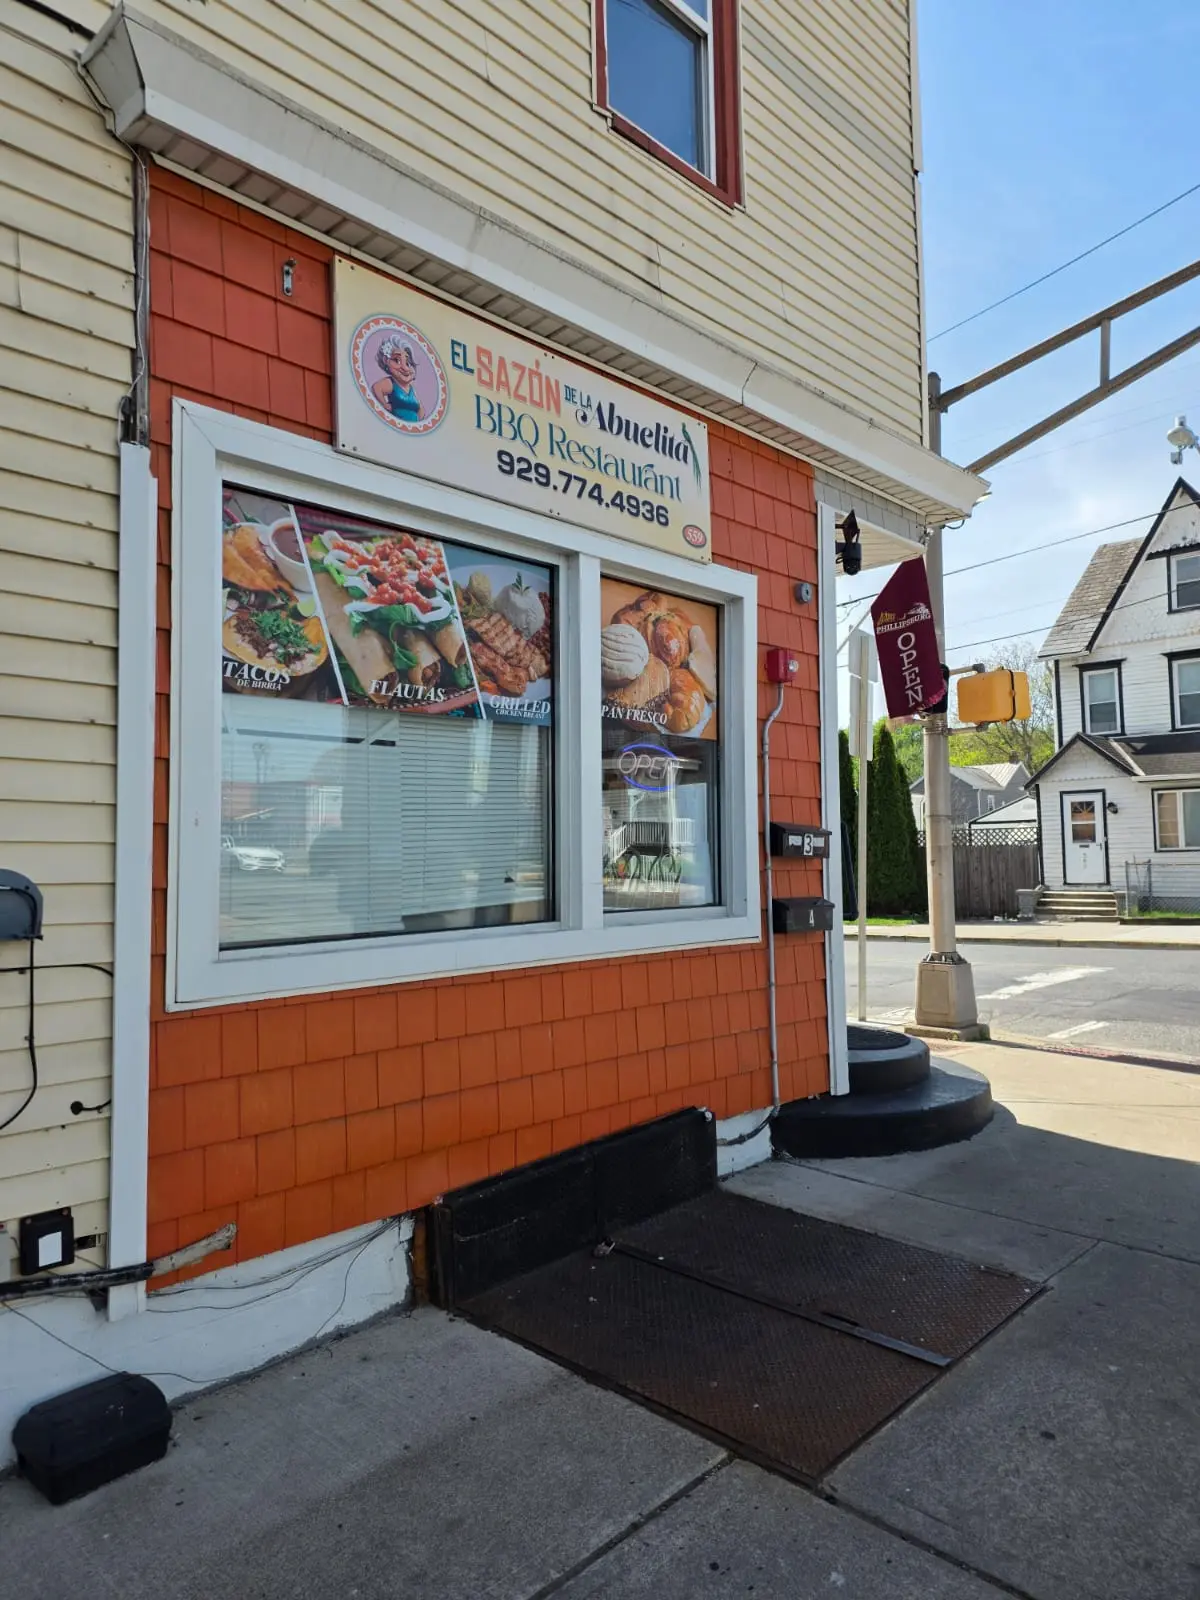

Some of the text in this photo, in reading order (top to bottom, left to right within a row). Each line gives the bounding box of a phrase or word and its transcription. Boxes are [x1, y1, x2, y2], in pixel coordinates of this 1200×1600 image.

[450, 338, 689, 464] EL SAZÓN DE LA Abuelita
[474, 393, 682, 502] BBQ Restaurant
[497, 449, 670, 527] 929.774.4936
[876, 613, 931, 635] PHILLIPSBURG
[223, 661, 291, 685] TACOS
[897, 632, 924, 707] OPEN
[237, 679, 282, 691] DE BIRRIA
[368, 679, 445, 702] FLAUTAS
[490, 694, 551, 714] GRILLED
[626, 708, 668, 725] FRESCO
[804, 834, 813, 855] 3
[809, 908, 815, 927] 4
